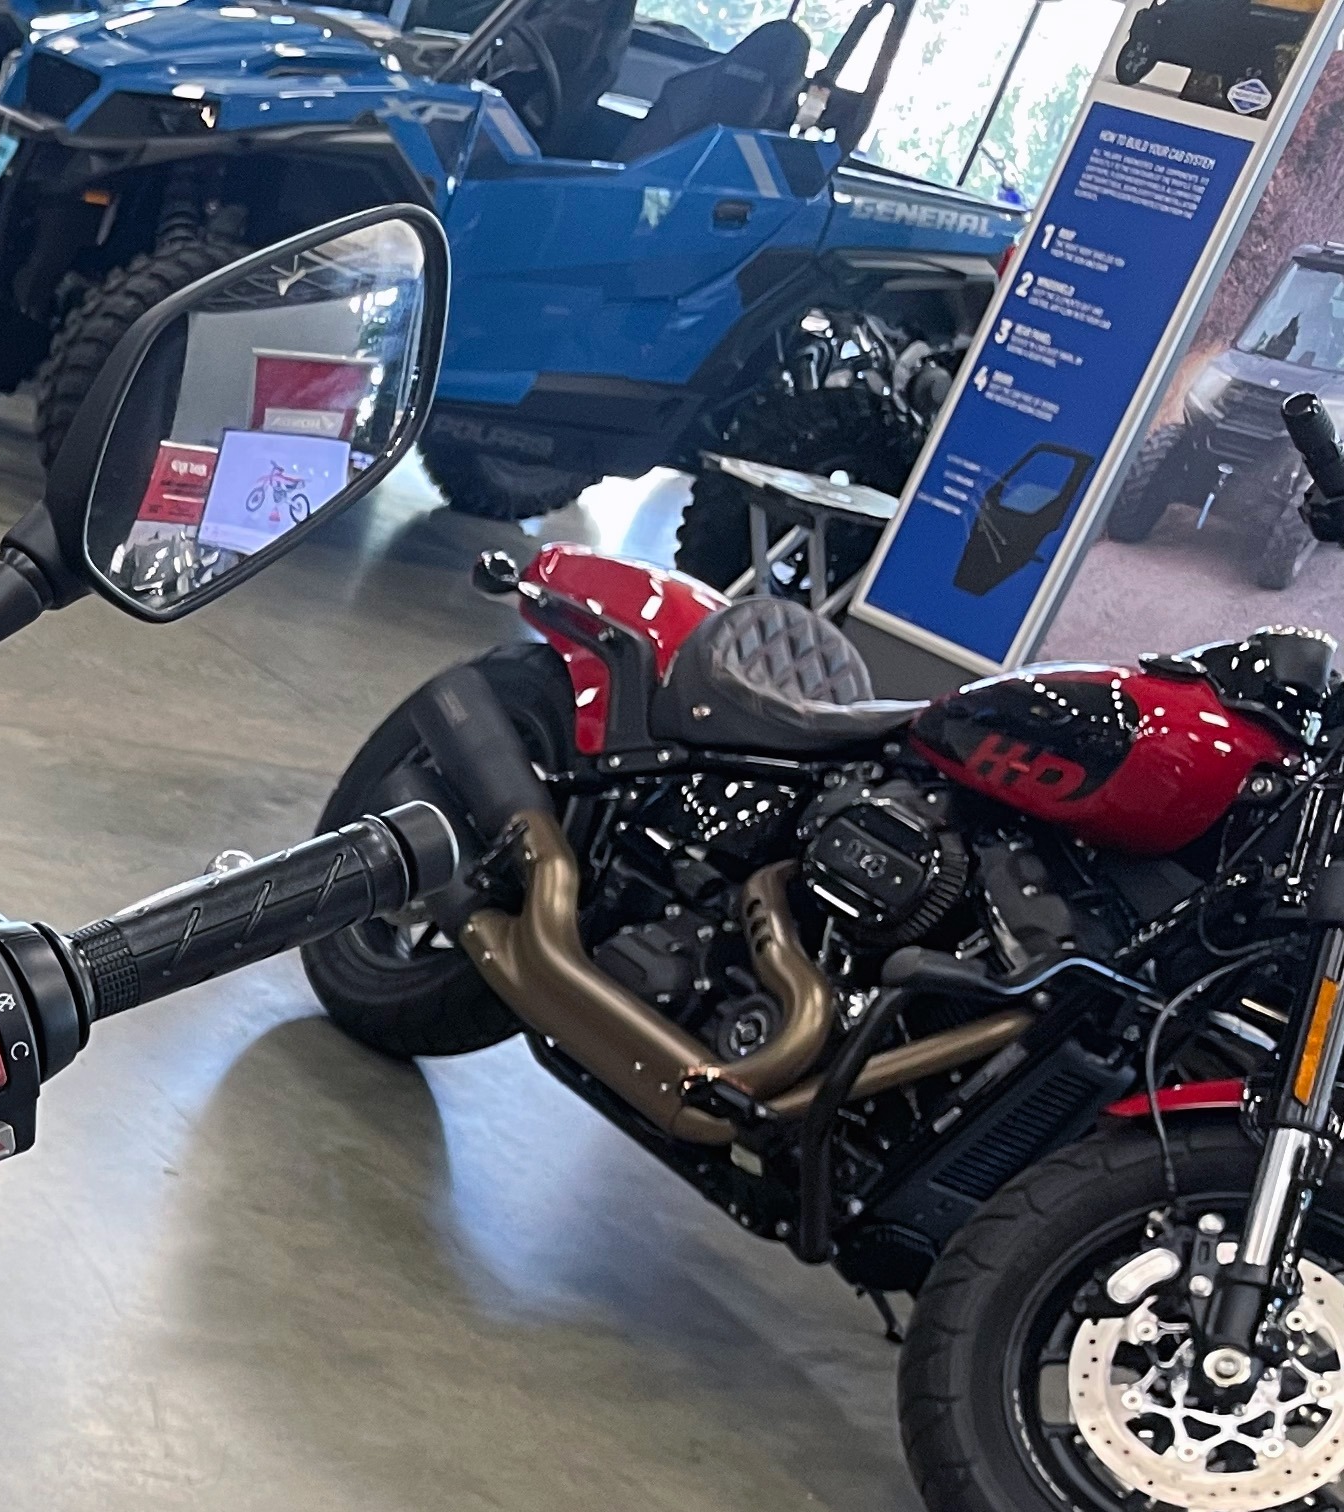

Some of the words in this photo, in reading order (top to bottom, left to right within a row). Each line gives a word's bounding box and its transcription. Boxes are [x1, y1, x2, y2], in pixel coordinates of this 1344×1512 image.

[374, 95, 473, 125] XP
[1168, 148, 1186, 163] CAB
[1183, 151, 1217, 171] SYSTEM
[849, 197, 996, 239] GENERAL
[1041, 223, 1056, 250] 1
[1015, 270, 1034, 298] 2
[994, 317, 1013, 345] 3
[973, 364, 989, 392] 4
